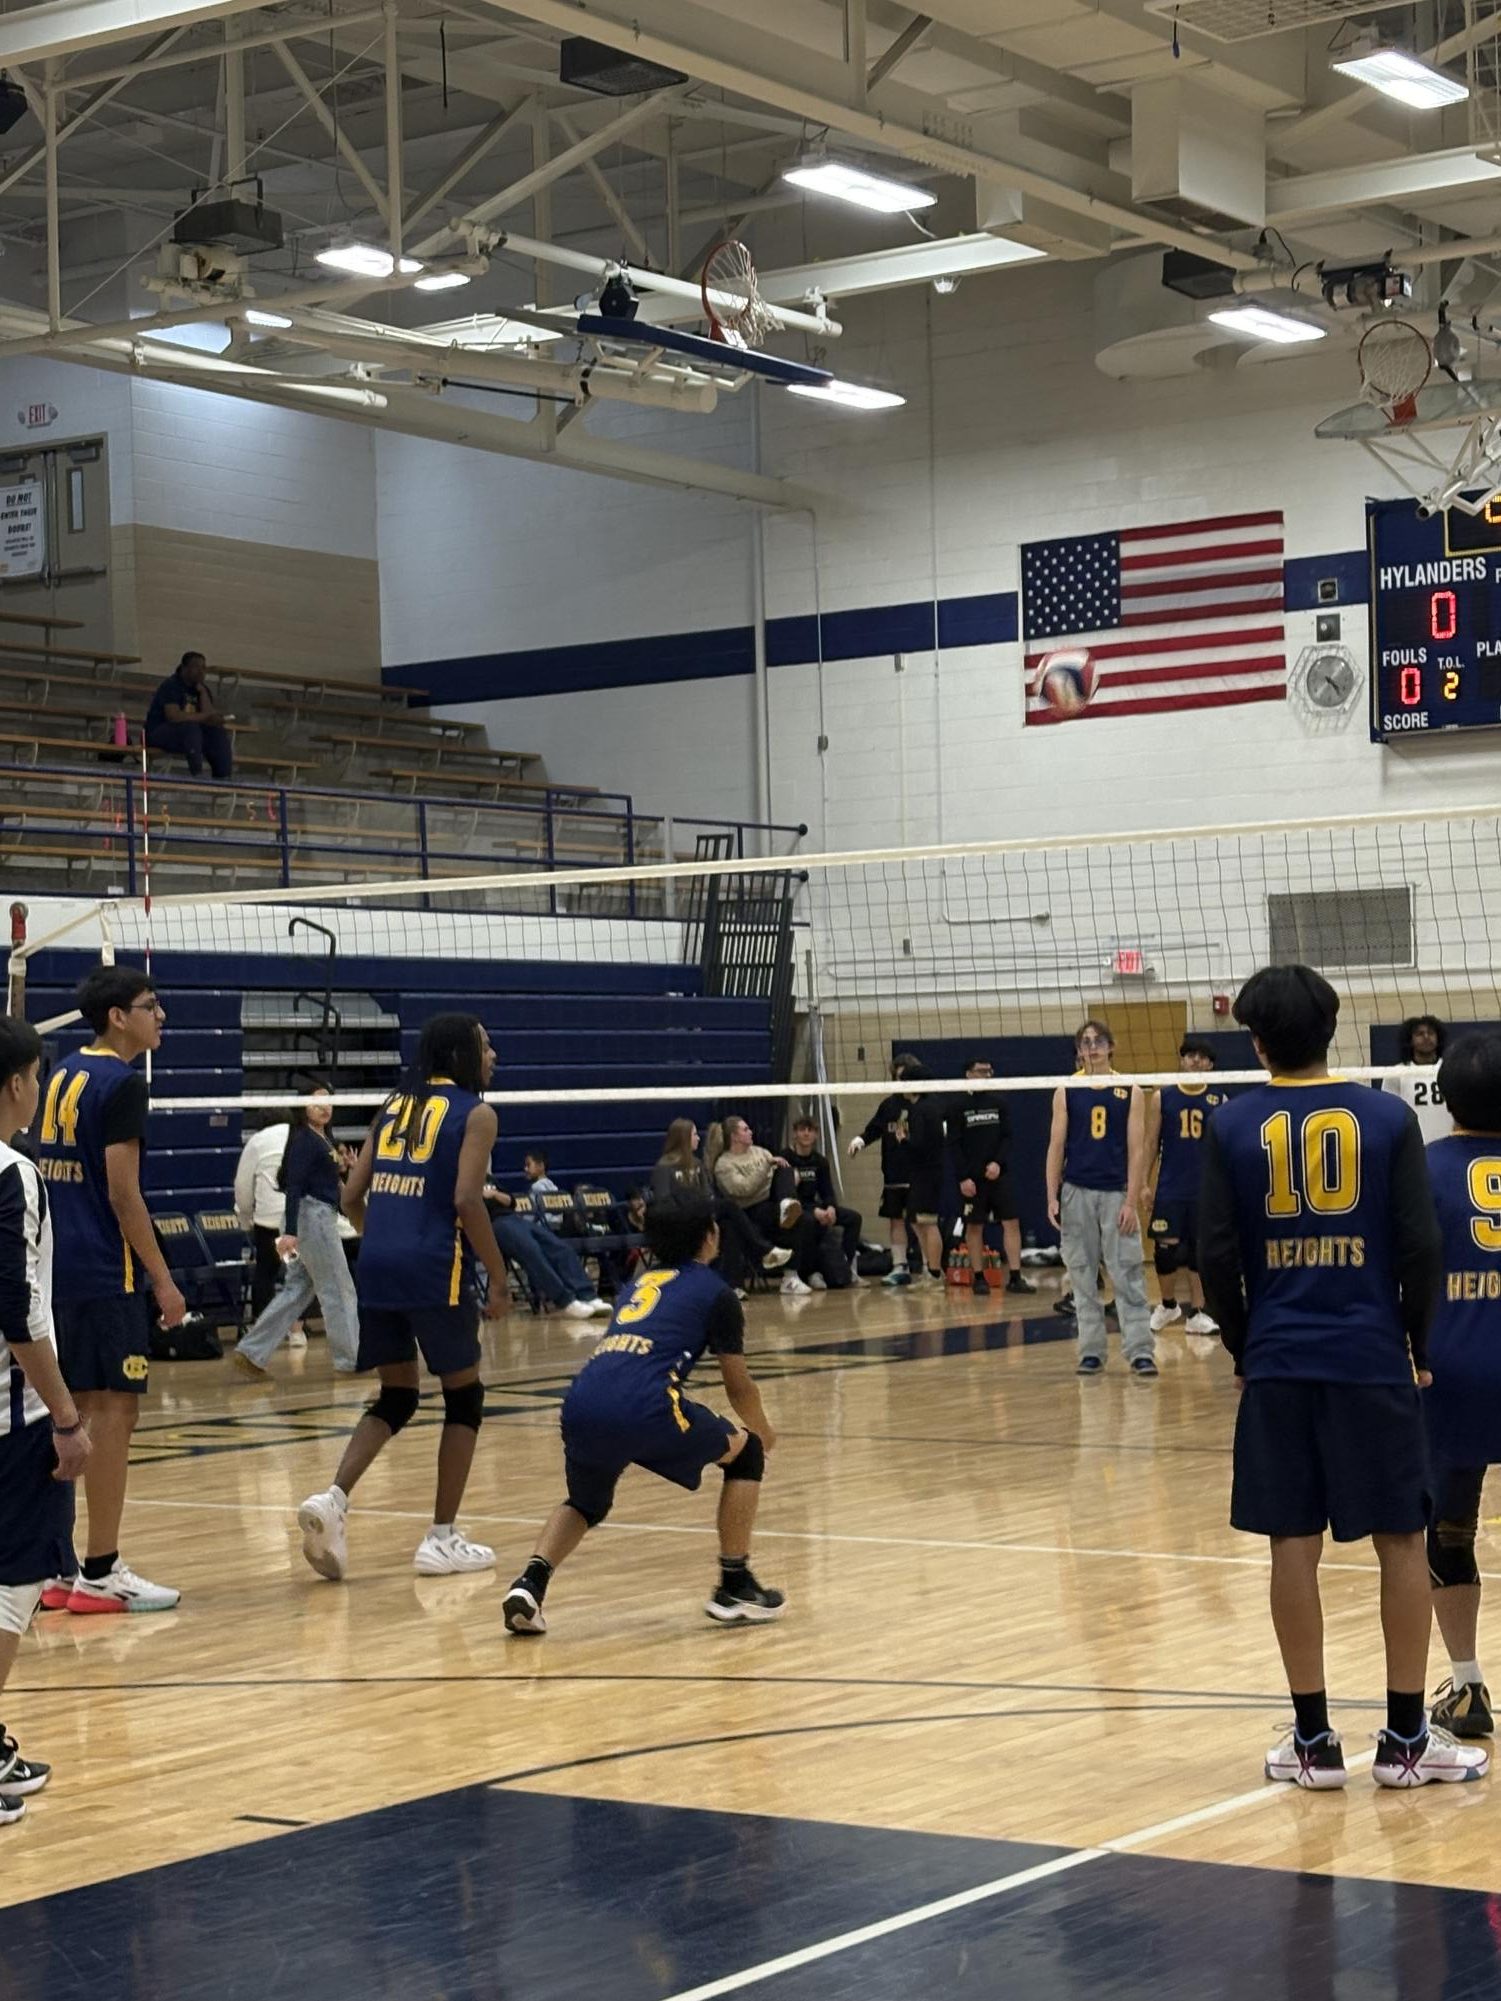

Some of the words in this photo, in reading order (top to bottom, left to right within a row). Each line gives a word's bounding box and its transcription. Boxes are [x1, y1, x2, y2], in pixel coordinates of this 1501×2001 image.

[29, 404, 46, 424] EXIT
[1380, 557, 1487, 590] HYLANDERS
[1431, 590, 1457, 640] 0
[1383, 647, 1428, 667] FOULS
[1437, 656, 1465, 670] T.O.L.
[1401, 667, 1421, 705] 0
[1444, 671, 1459, 700] 2
[1384, 711, 1429, 730] SCORE
[1117, 951, 1140, 972] EXIT
[41, 1067, 90, 1147] 14
[1414, 1081, 1445, 1106] 28
[376, 1093, 450, 1164] 20
[1091, 1105, 1107, 1140] 8
[1179, 1108, 1204, 1139] 16
[1260, 1107, 1361, 1218] 10
[371, 1171, 426, 1198] HEIGHTS
[1466, 1156, 1501, 1252] 9
[1265, 1235, 1365, 1270] HEIGHTS
[616, 1267, 680, 1326] 3
[1446, 1270, 1501, 1302] HEIG
